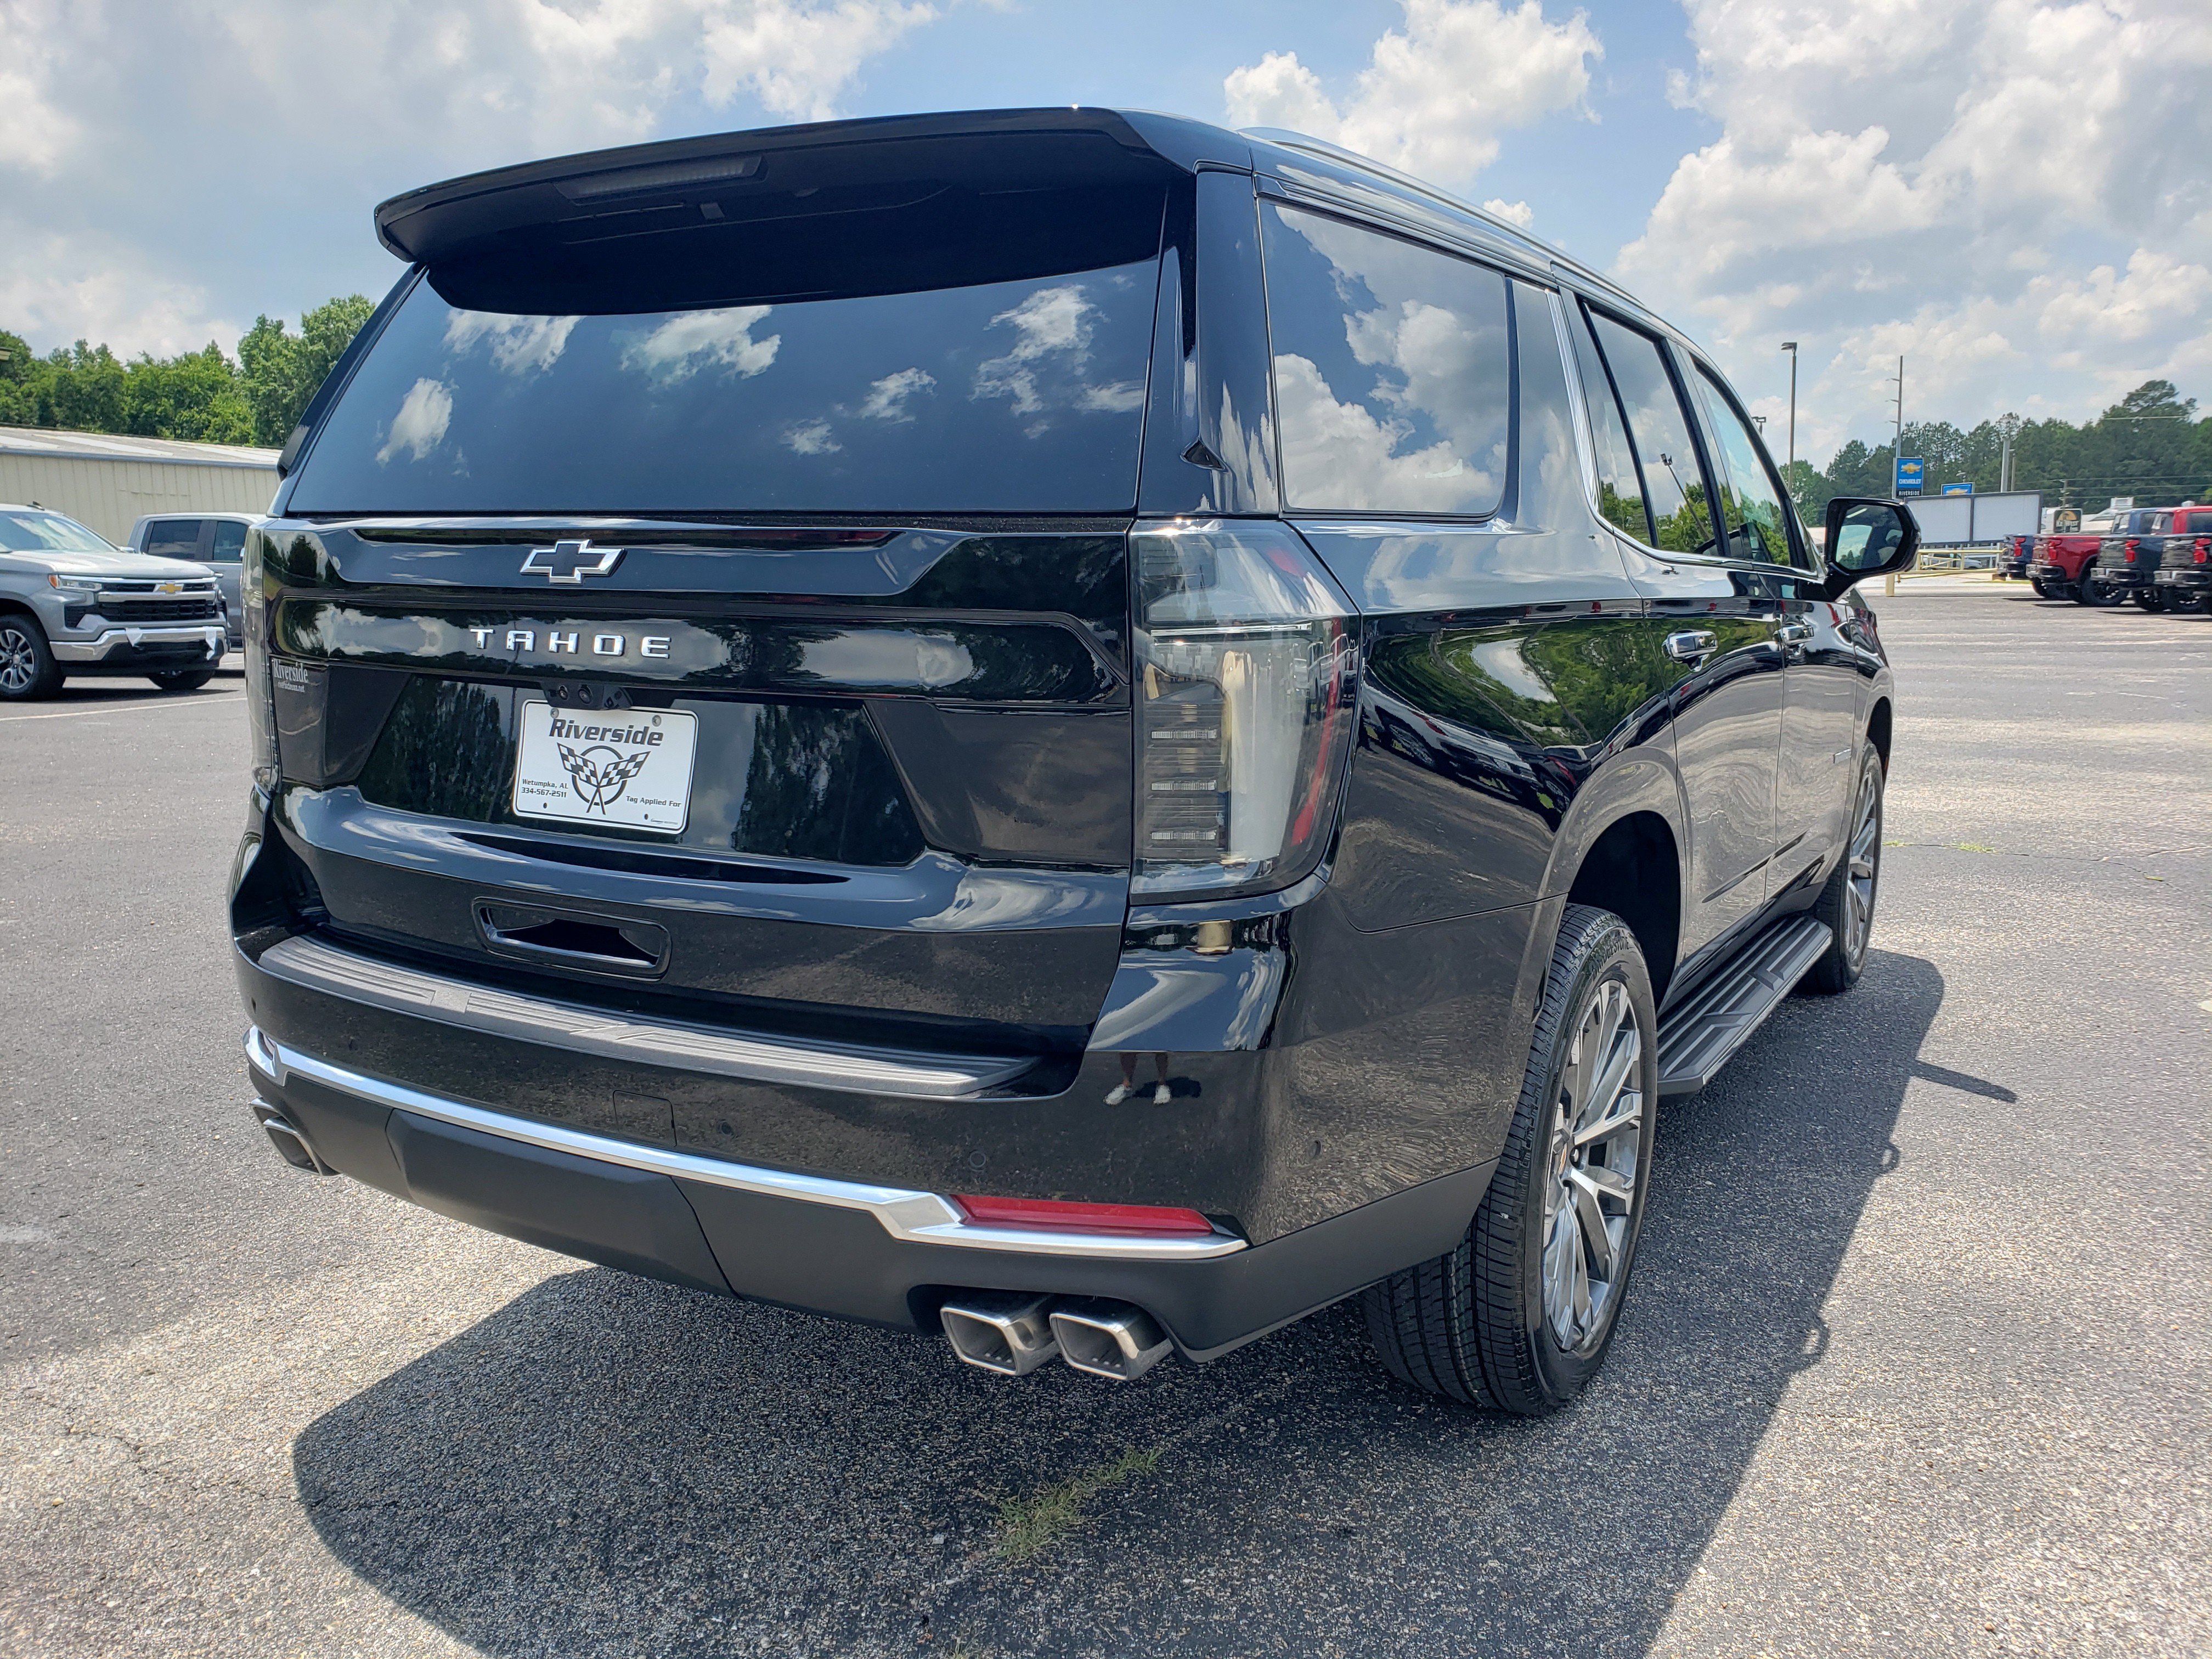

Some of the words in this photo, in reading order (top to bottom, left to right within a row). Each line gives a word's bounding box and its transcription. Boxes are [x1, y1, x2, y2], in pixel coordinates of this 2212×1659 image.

[470, 628, 672, 658] TAHOE
[274, 658, 308, 683] Riverside
[549, 718, 664, 747] Riverside
[522, 778, 557, 788] Wetumpka,
[521, 787, 567, 798] 334-567-2511
[626, 795, 638, 804] Tag
[640, 797, 667, 806] Applied
